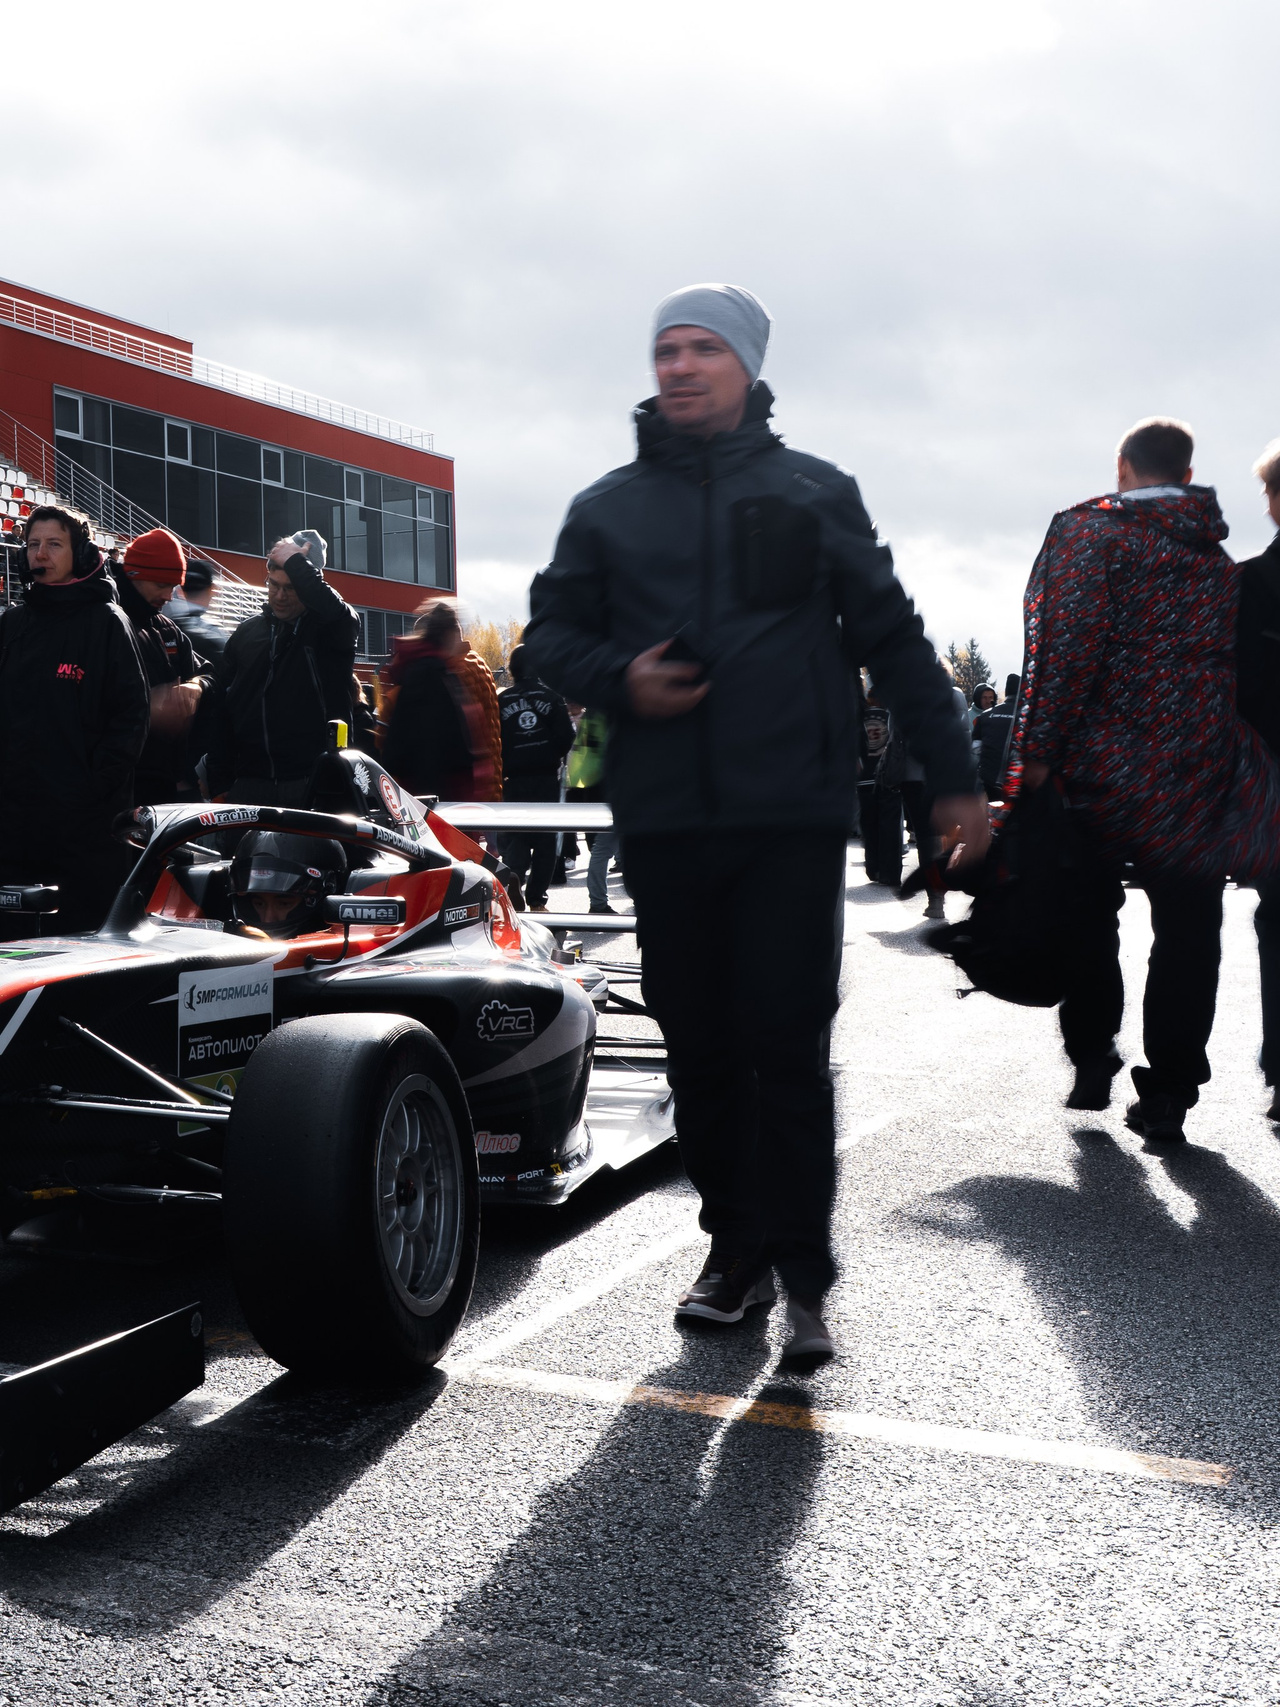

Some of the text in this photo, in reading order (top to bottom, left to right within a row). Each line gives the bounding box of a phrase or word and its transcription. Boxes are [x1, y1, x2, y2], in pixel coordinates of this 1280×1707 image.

[377, 828, 419, 855] АБРОСИМОВ
[342, 907, 397, 919] AIMOL
[488, 1015, 529, 1031] VRC
[507, 1169, 545, 1181] PORT
